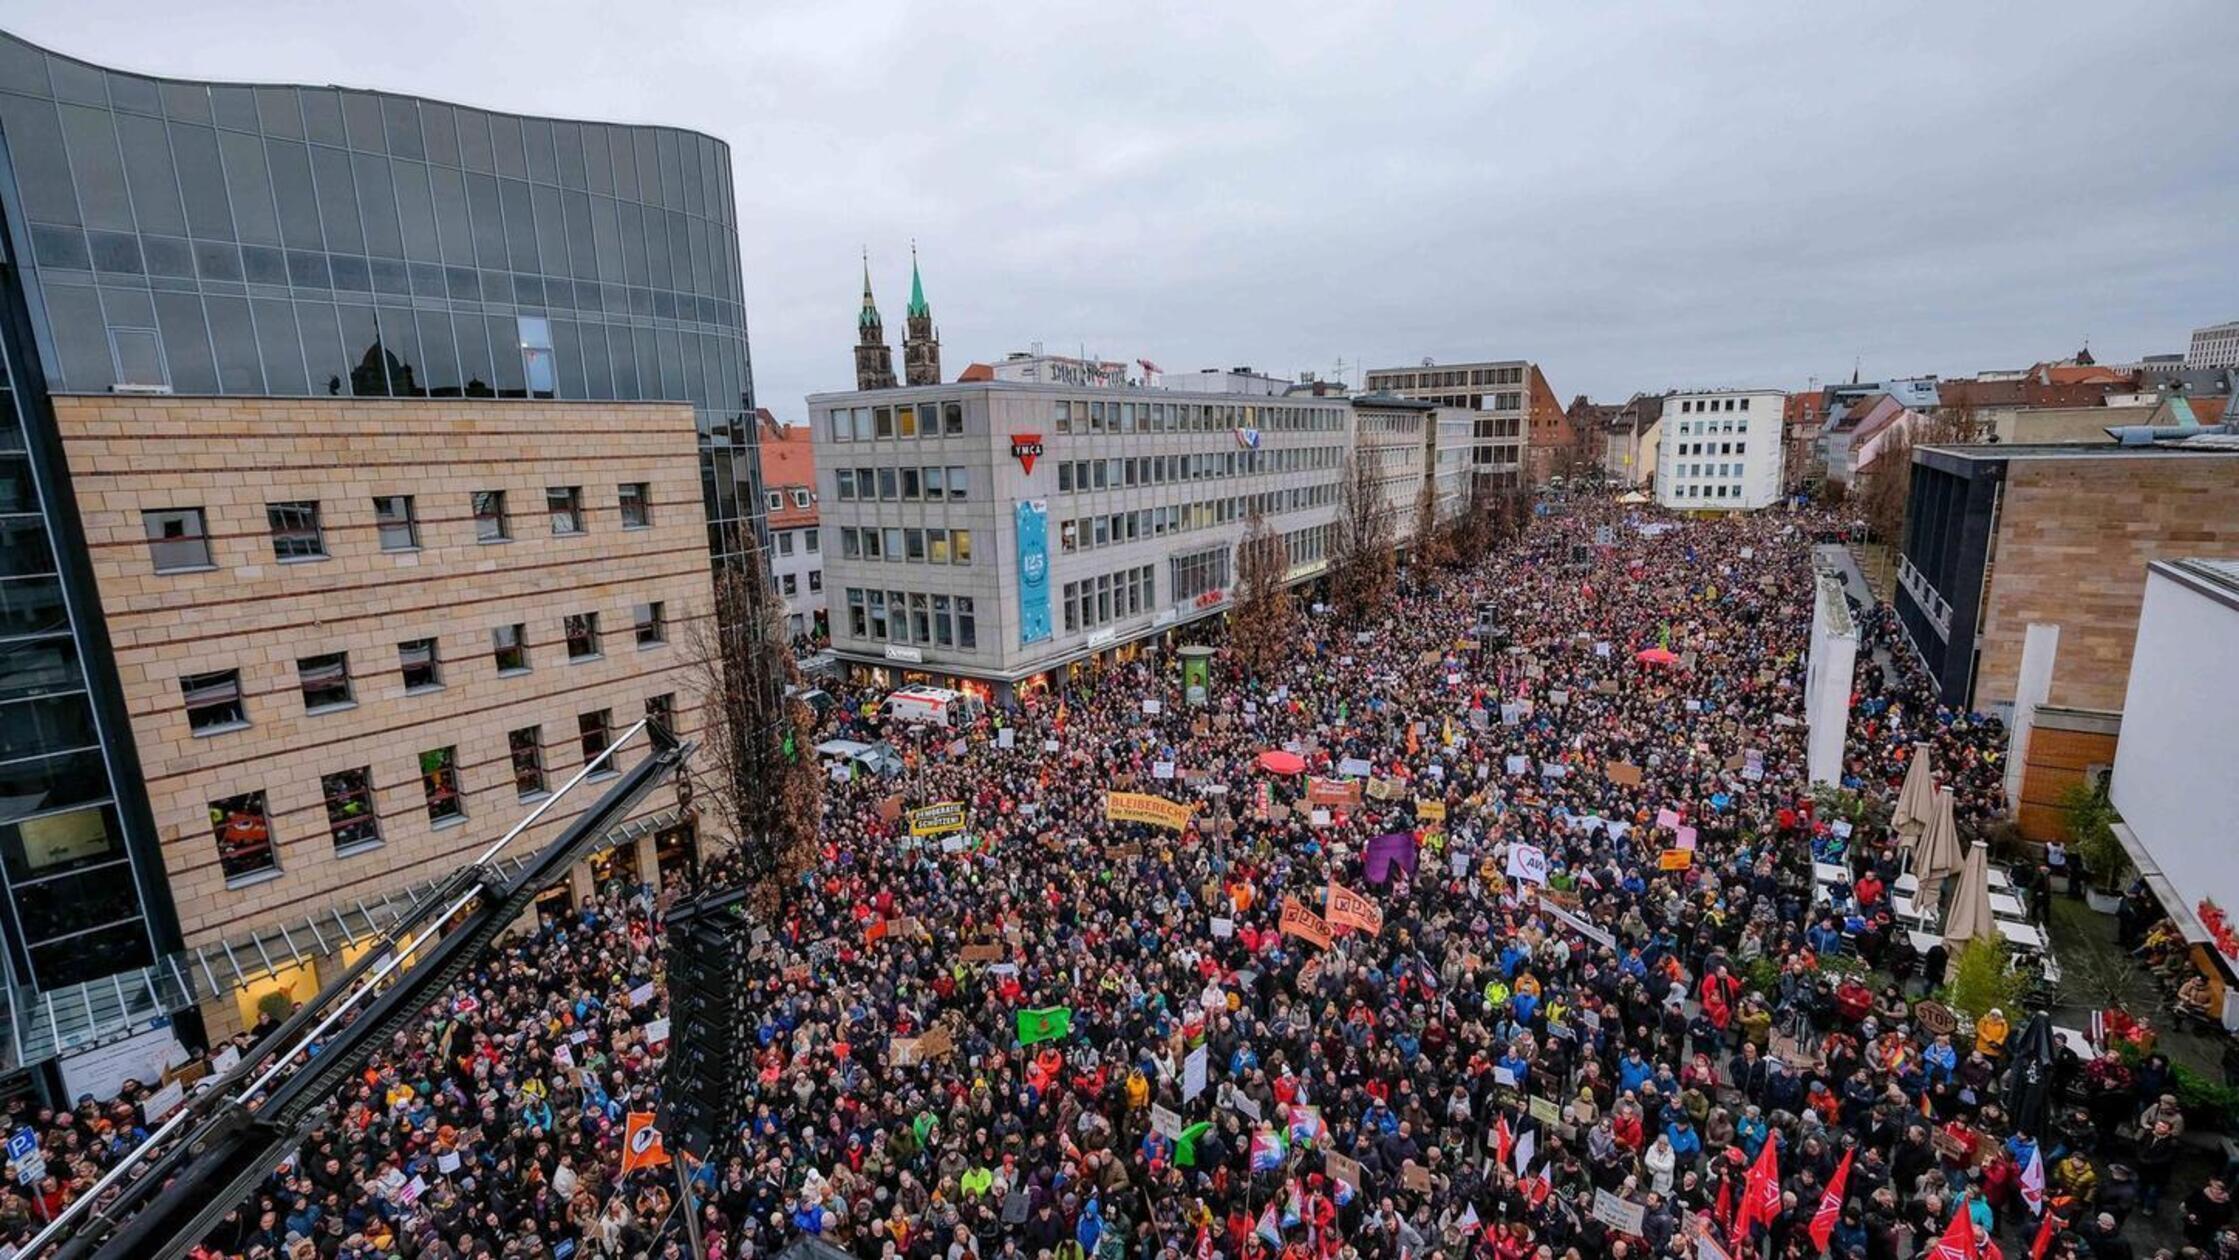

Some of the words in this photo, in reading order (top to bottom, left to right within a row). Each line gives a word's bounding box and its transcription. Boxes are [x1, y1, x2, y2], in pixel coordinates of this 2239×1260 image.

[1015, 445, 1042, 456] YMCA
[1024, 554, 1043, 574] 125
[915, 804, 961, 819] DEMOKRATIE
[1111, 796, 1188, 820] BLEIBERECHT
[1919, 1006, 1952, 1027] STOP
[11, 1135, 27, 1157] P
